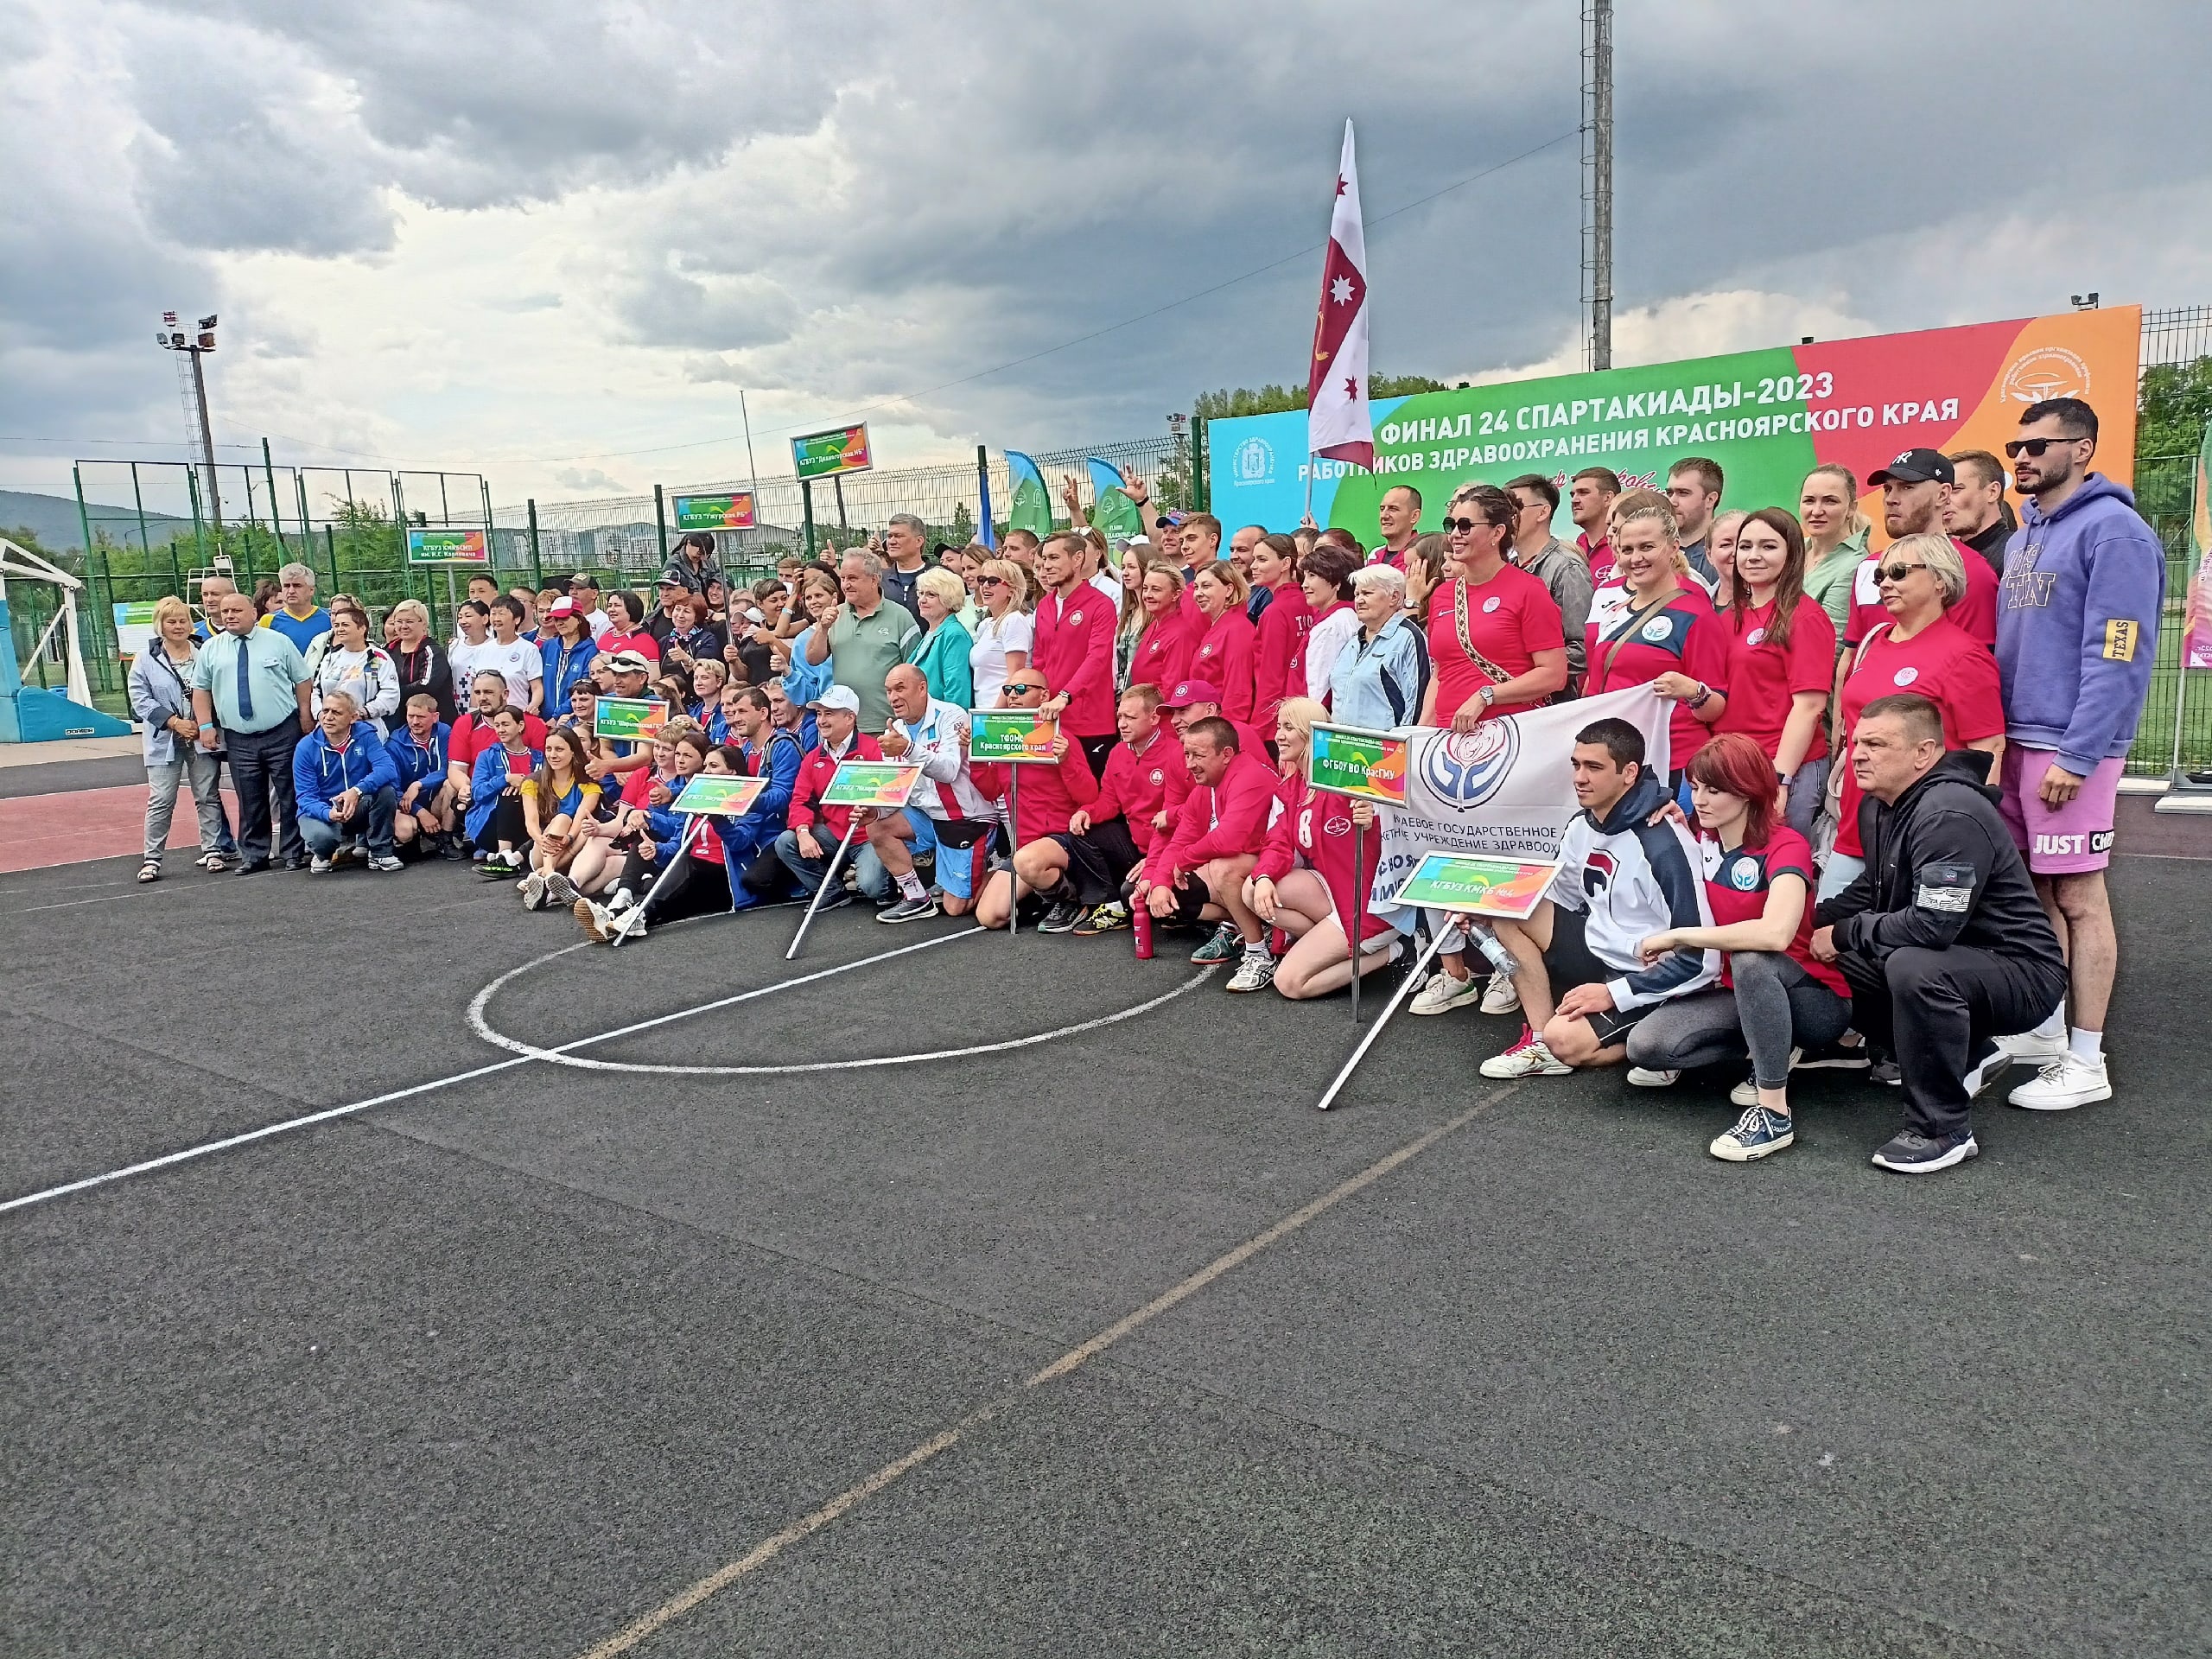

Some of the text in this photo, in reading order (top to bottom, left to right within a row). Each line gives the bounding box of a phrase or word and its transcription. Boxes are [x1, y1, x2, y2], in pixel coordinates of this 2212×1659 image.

[1380, 372, 1834, 445] ФИНАЛ 24 СПАРТАКИАДЫ-2023
[1428, 429, 1649, 471] ЗДРАВООХРАНЕНИЯ
[1656, 405, 1874, 448] КРАСНОЯРСКОГО
[1882, 397, 1960, 426] КРАЯ
[2112, 621, 2129, 658] TEXAS
[980, 741, 1046, 753] Красноярского края
[1322, 759, 1395, 780] ФГБОУ ВО КрасГМУ
[1437, 823, 1558, 838] ГОСУДАРСТВЕННОЕ
[1414, 831, 1489, 849] УЧРЕЖДЕНИЕ
[1492, 841, 1560, 854] ЗДРАВООХ
[2033, 834, 2085, 855] JUST
[1430, 880, 1463, 892] КГБУЗ
[1463, 883, 1496, 896] КМКБ
